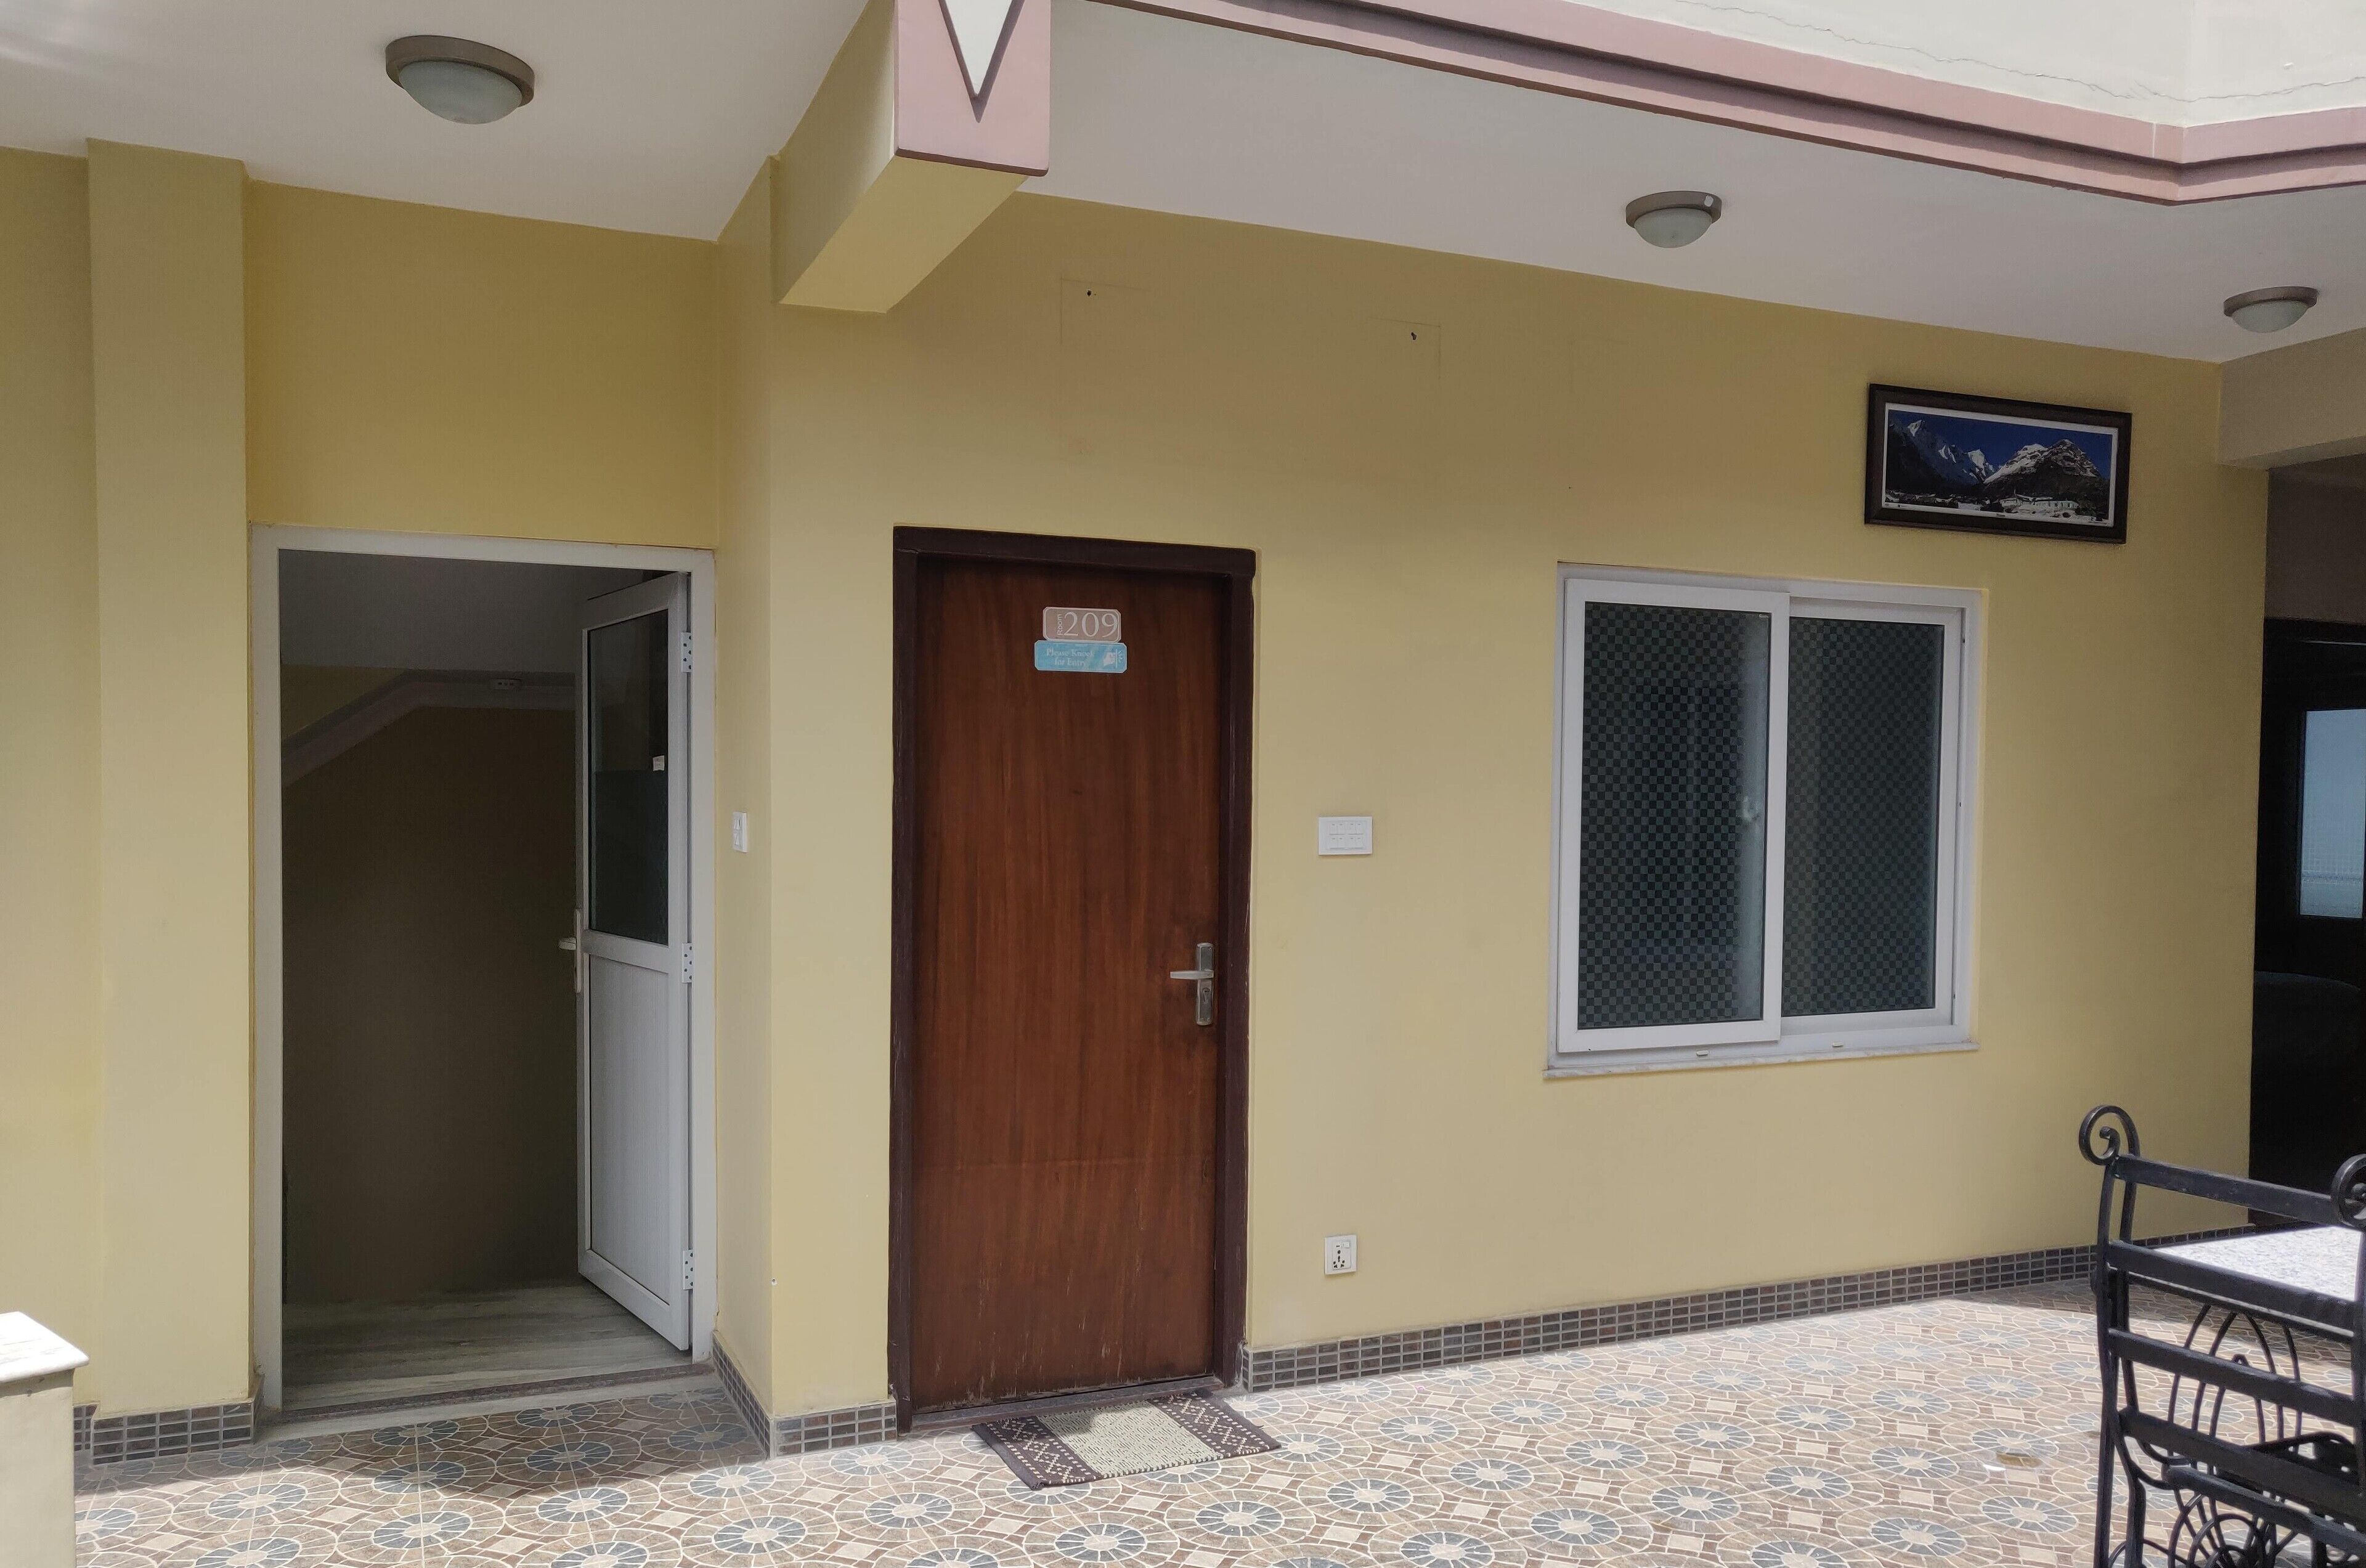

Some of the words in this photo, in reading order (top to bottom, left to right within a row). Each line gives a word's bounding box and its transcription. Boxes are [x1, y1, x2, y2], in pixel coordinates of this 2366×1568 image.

[1063, 611, 1118, 638] 209
[1046, 647, 1069, 656] Please
[1054, 657, 1065, 665] for
